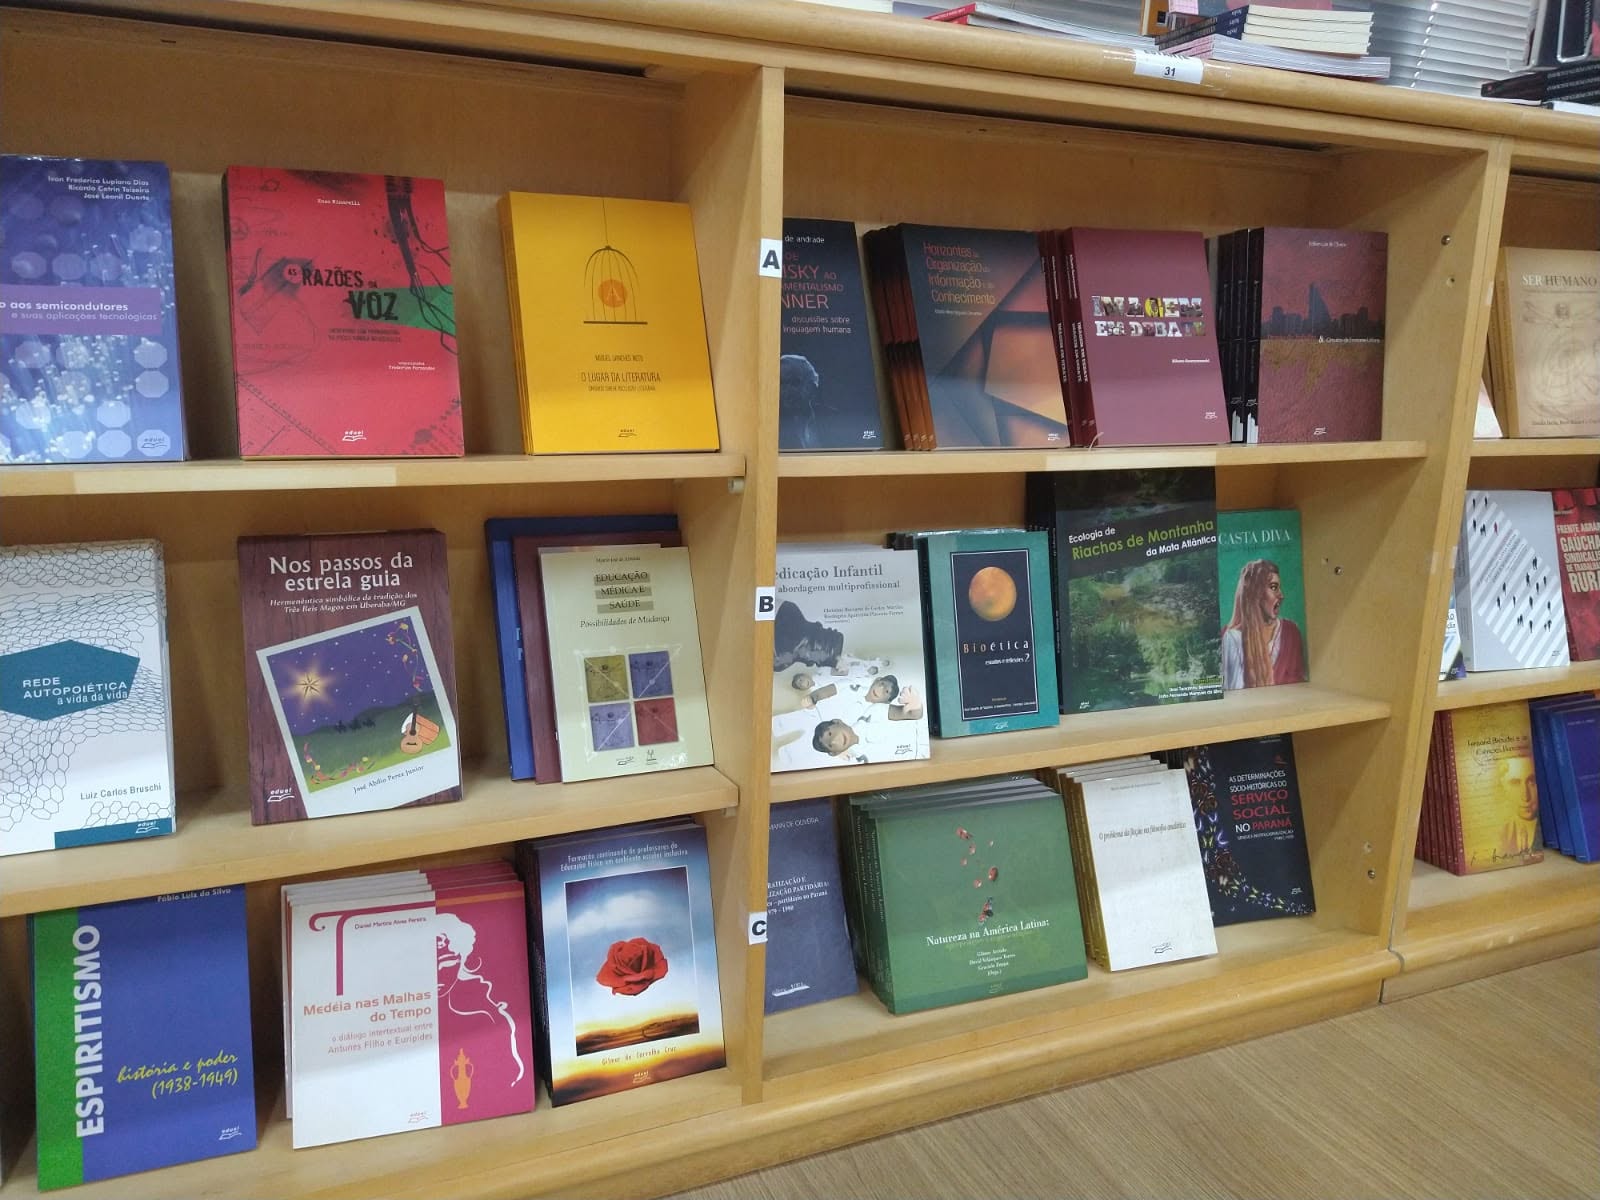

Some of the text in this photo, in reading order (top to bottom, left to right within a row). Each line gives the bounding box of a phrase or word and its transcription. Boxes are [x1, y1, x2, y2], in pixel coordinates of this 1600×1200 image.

[1164, 66, 1176, 77] 31
[796, 235, 825, 244] andrade
[923, 242, 972, 258] Horizontes
[762, 249, 781, 270] A
[925, 256, 983, 273] Organização
[302, 266, 364, 288] RAZÕES
[824, 271, 837, 280] AO
[928, 273, 982, 289] Informação
[1521, 274, 1598, 288] SER HUMANO
[348, 289, 399, 321] VOZ
[931, 289, 996, 305] Conhecimento
[10, 301, 129, 311] aos semicondutores
[1091, 295, 1204, 318] IMAGEM
[46, 312, 97, 321] aplicações
[822, 325, 852, 334] humana
[1129, 321, 1206, 337] DEBATE
[588, 372, 610, 382] LUGAR
[622, 372, 662, 383] LITERATURA
[1068, 526, 1116, 545] Ecologia de
[1072, 518, 1214, 561] Riachos de Montanha
[1218, 528, 1292, 546] CASTA DIVA
[1146, 533, 1218, 557] da Mata Atlântica
[269, 551, 414, 575] Nos passos da
[834, 563, 883, 579] Infantil
[285, 570, 401, 592] estrela guia
[595, 570, 648, 583] EDUCAÇÃO
[601, 585, 638, 596] MÉDICA
[778, 580, 901, 595] abordagem multiprofissional
[270, 591, 418, 607] Hermenêutica simbólica da tradição dos
[302, 605, 318, 613] Reis
[319, 603, 345, 614] Magos
[346, 603, 358, 611] em
[359, 599, 407, 610] Uberaba/MG
[609, 598, 641, 610] SAÚDE
[758, 596, 774, 612] B
[580, 614, 670, 629] Possibilidades de Mudança
[963, 640, 1029, 654] Bioética
[22, 677, 61, 688] REDE
[23, 681, 128, 699] AUTOPOIÉTICA
[57, 690, 128, 706] a vida da vida
[1229, 769, 1286, 783] AS DETERMINAÇÕES
[80, 782, 162, 801] Luiz Carlos Bruschi
[1229, 779, 1287, 793] SÓCIO-HISTÓRICAS DO
[1231, 789, 1289, 806] SERVIÇO
[1233, 804, 1291, 820] SOCIAL
[1235, 817, 1292, 833] NO PARANÁ
[1104, 831, 1123, 842] problema
[212, 887, 231, 897] Silva
[355, 922, 371, 930] Daniel
[752, 920, 766, 936] C
[926, 933, 968, 946] Natureza
[969, 930, 980, 939] na
[983, 924, 1018, 938] América
[1020, 918, 1050, 931] Latina:
[303, 990, 432, 1017] Medéia nas Malhas
[370, 1005, 432, 1023] do Tempo
[72, 924, 104, 1138] ESPIRITISMO
[339, 1022, 433, 1044] diálogo intertextual entre
[328, 1041, 361, 1054] Antunes
[364, 1039, 385, 1049] Filho
[395, 1032, 433, 1046] Eurípides
[625, 1053, 632, 1061] de
[116, 1049, 238, 1084] história e poder
[151, 1067, 239, 1099] (1938-1949)
